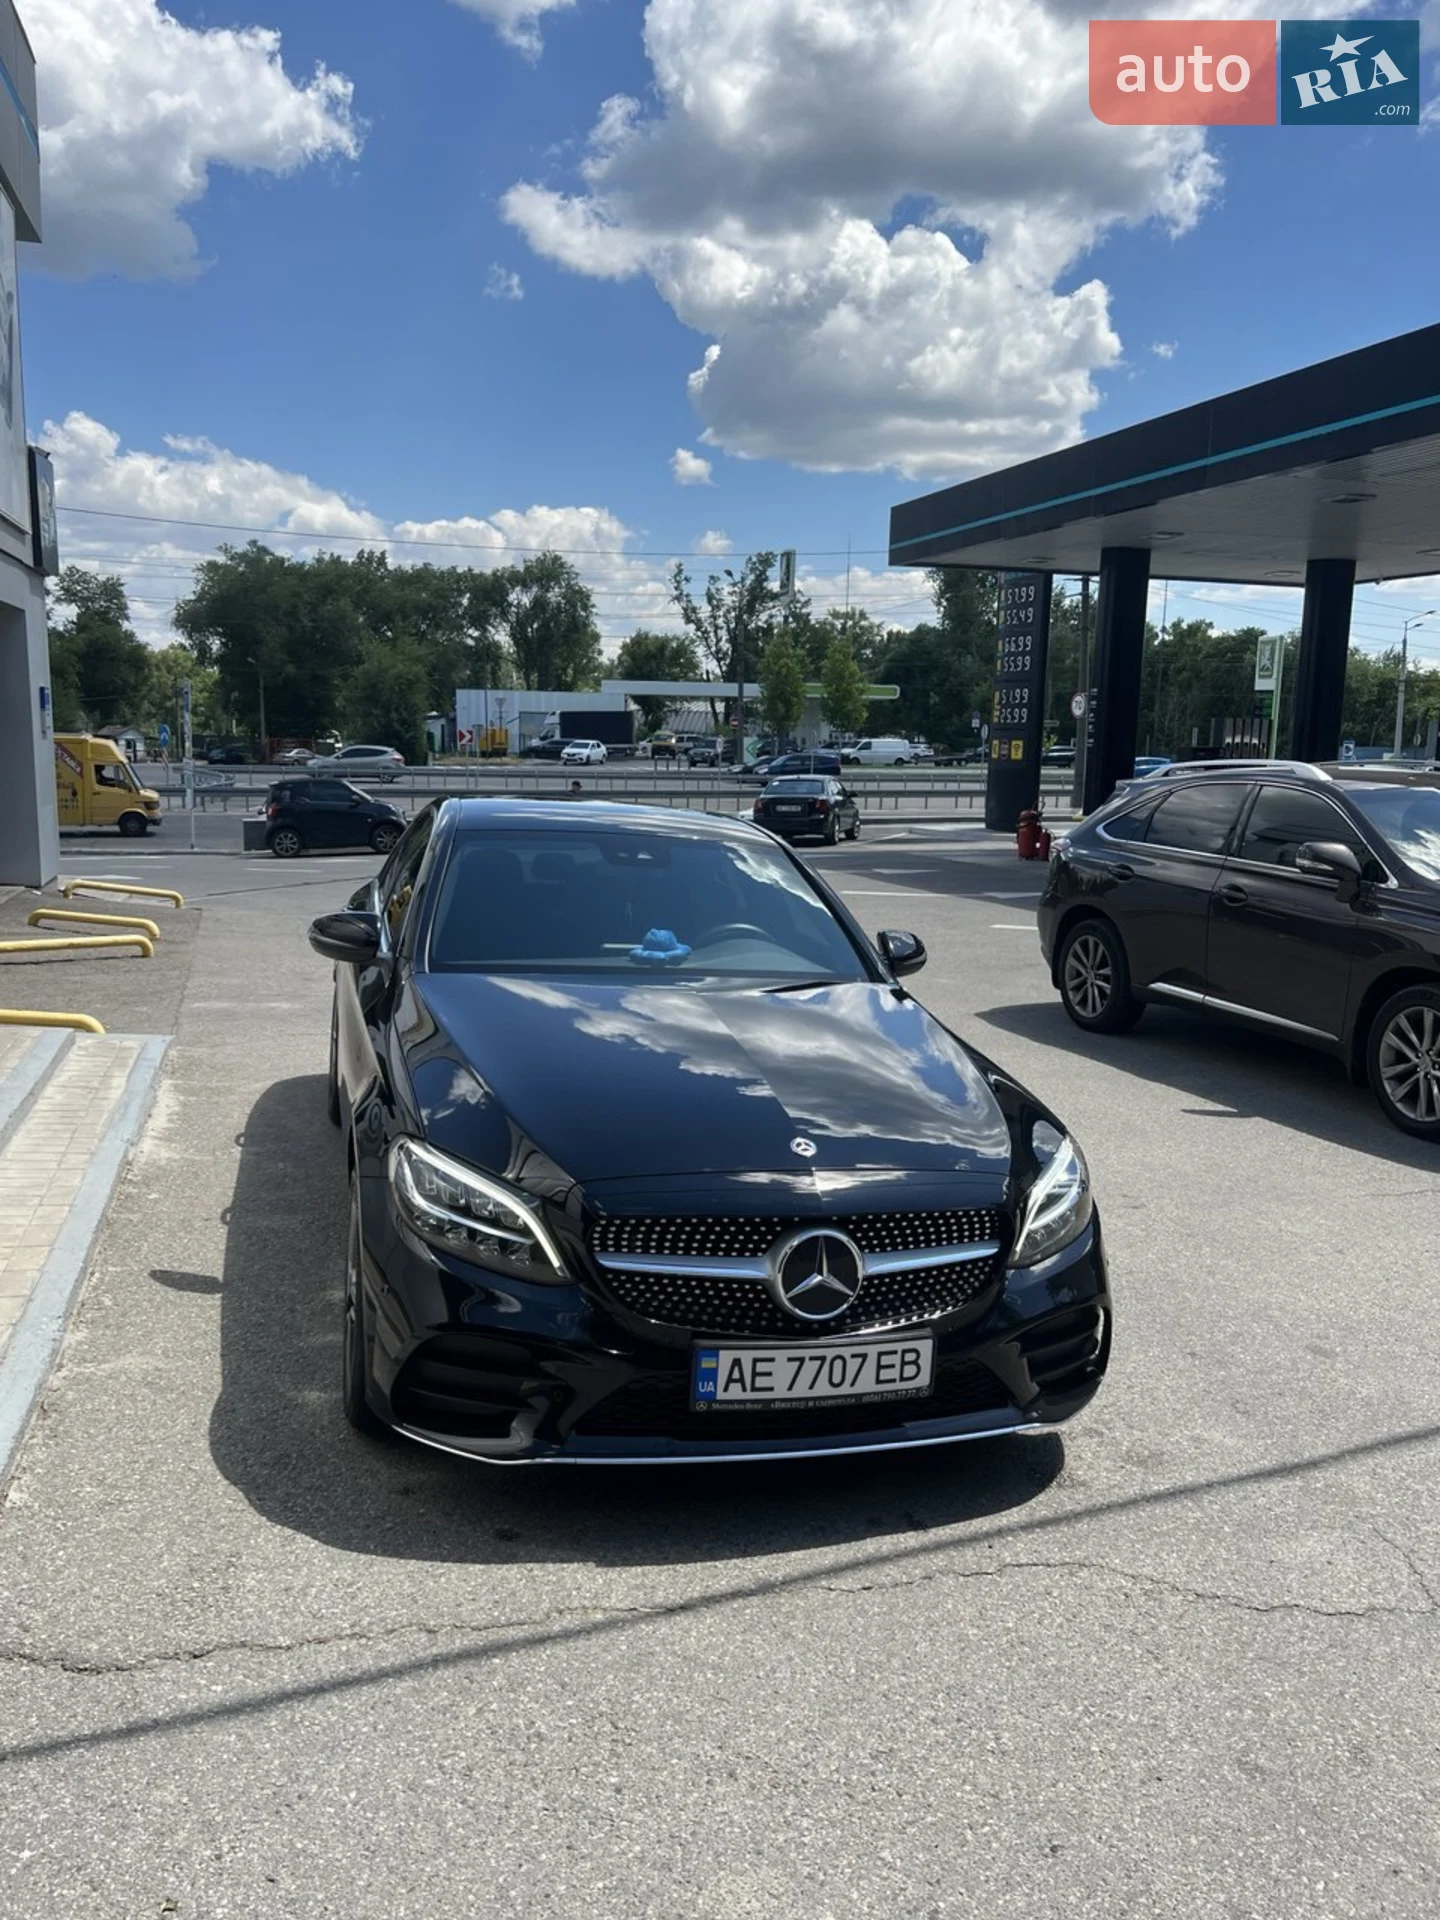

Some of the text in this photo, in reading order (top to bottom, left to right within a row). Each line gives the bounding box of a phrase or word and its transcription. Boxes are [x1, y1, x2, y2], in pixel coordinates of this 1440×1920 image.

[722, 1348, 922, 1393] AE 7707 EB
[698, 1381, 715, 1393] UA
